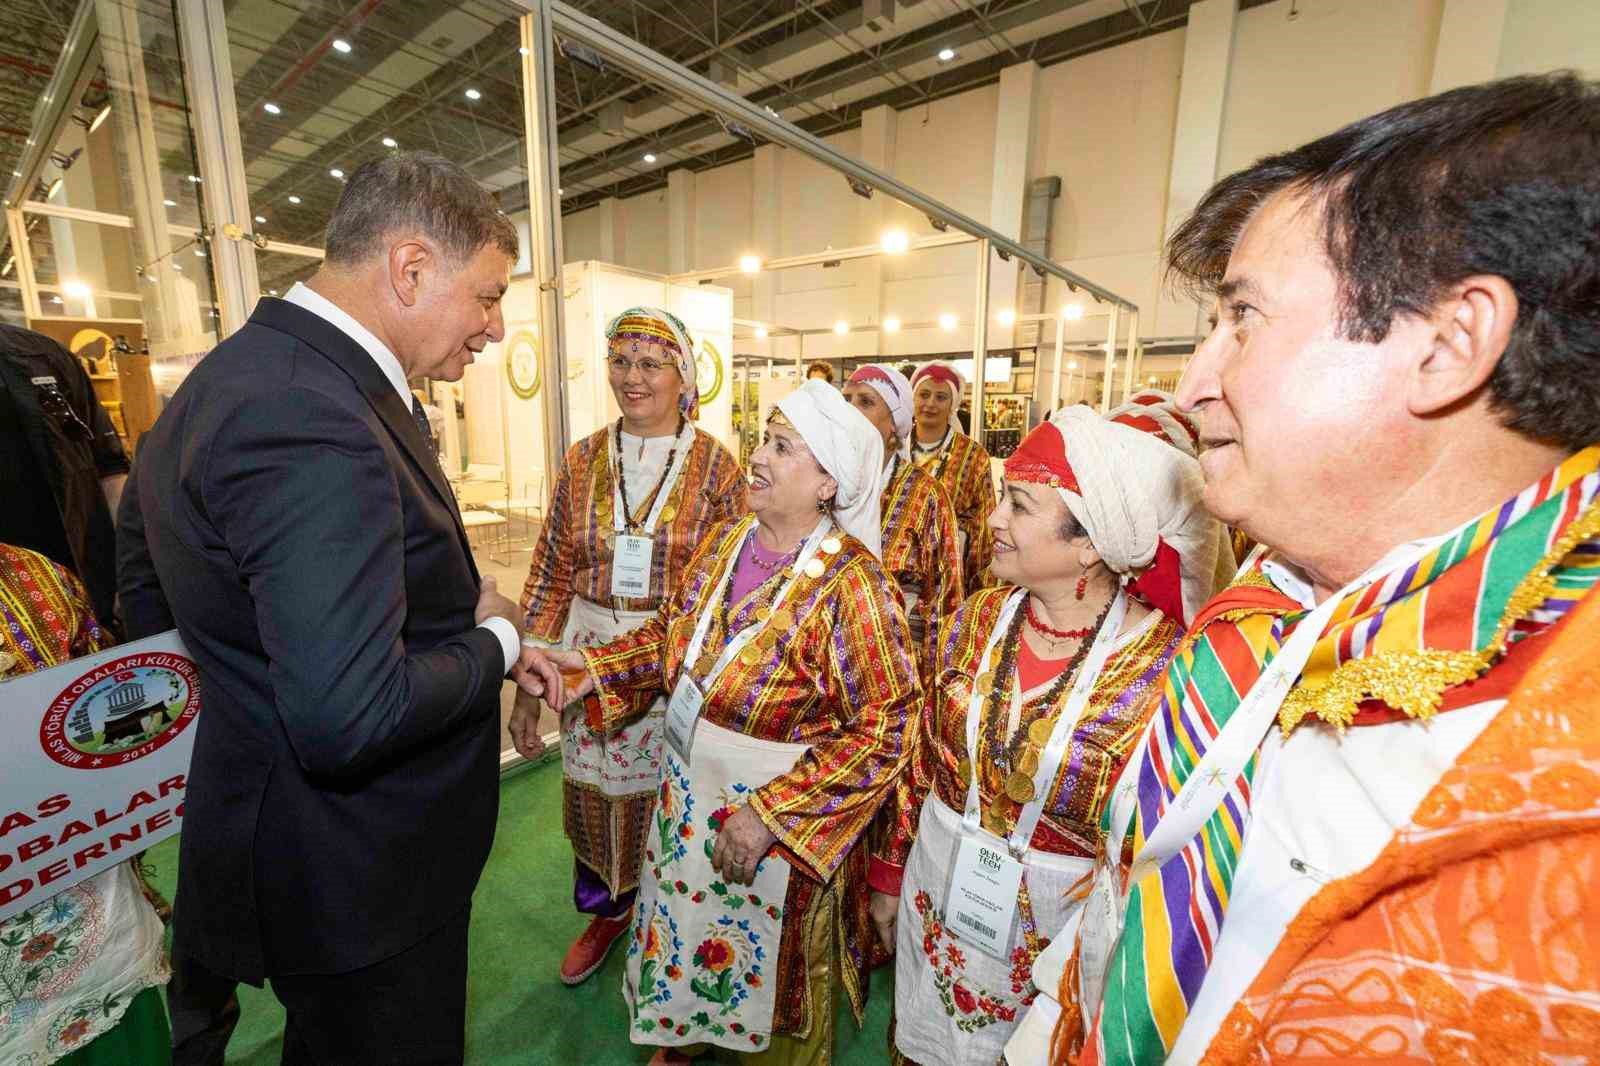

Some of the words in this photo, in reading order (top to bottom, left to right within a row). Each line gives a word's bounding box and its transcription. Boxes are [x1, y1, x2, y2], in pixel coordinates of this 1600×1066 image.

[46, 696, 74, 740] YÖRÜK
[72, 658, 141, 694] OBALARI
[145, 655, 193, 677] KÜLTÜR
[121, 743, 156, 762] 2017
[0, 801, 185, 908] DERNE
